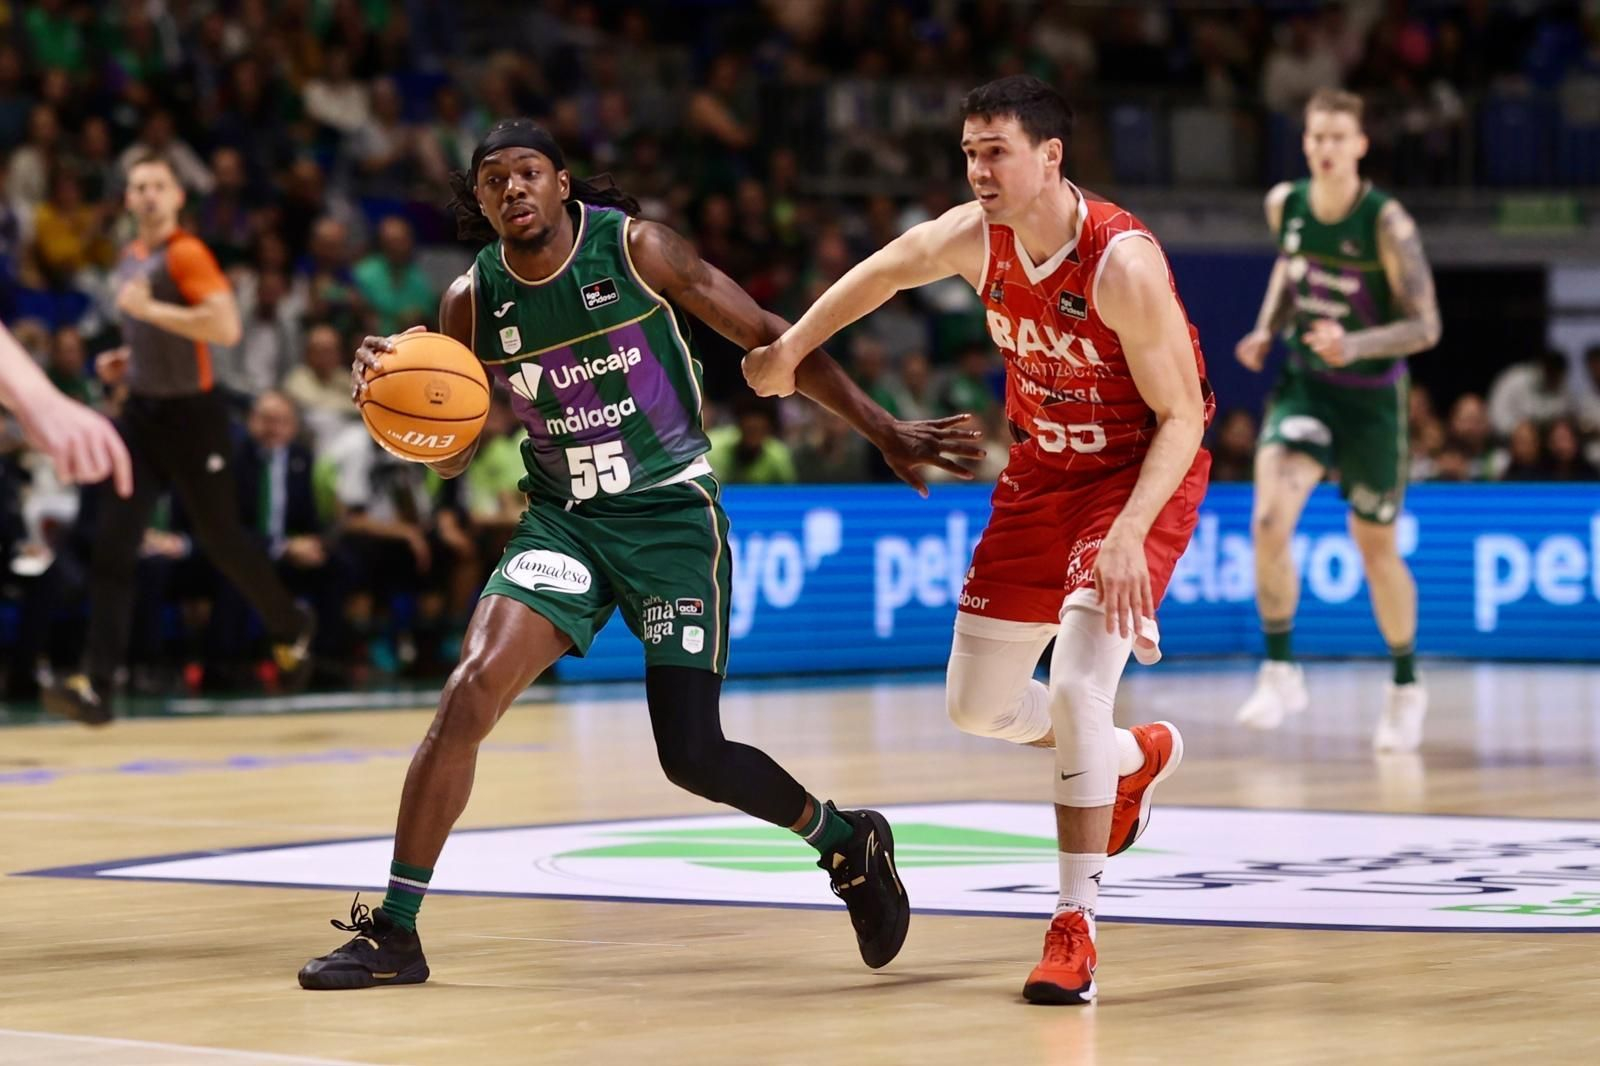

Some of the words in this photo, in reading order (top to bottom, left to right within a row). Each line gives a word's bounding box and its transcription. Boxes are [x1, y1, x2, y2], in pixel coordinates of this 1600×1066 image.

[550, 346, 642, 389] Unicaja
[546, 396, 637, 435] málaga
[402, 431, 456, 448] EVO
[565, 440, 631, 500] 55
[872, 511, 982, 638] pel
[679, 604, 698, 613] acb
